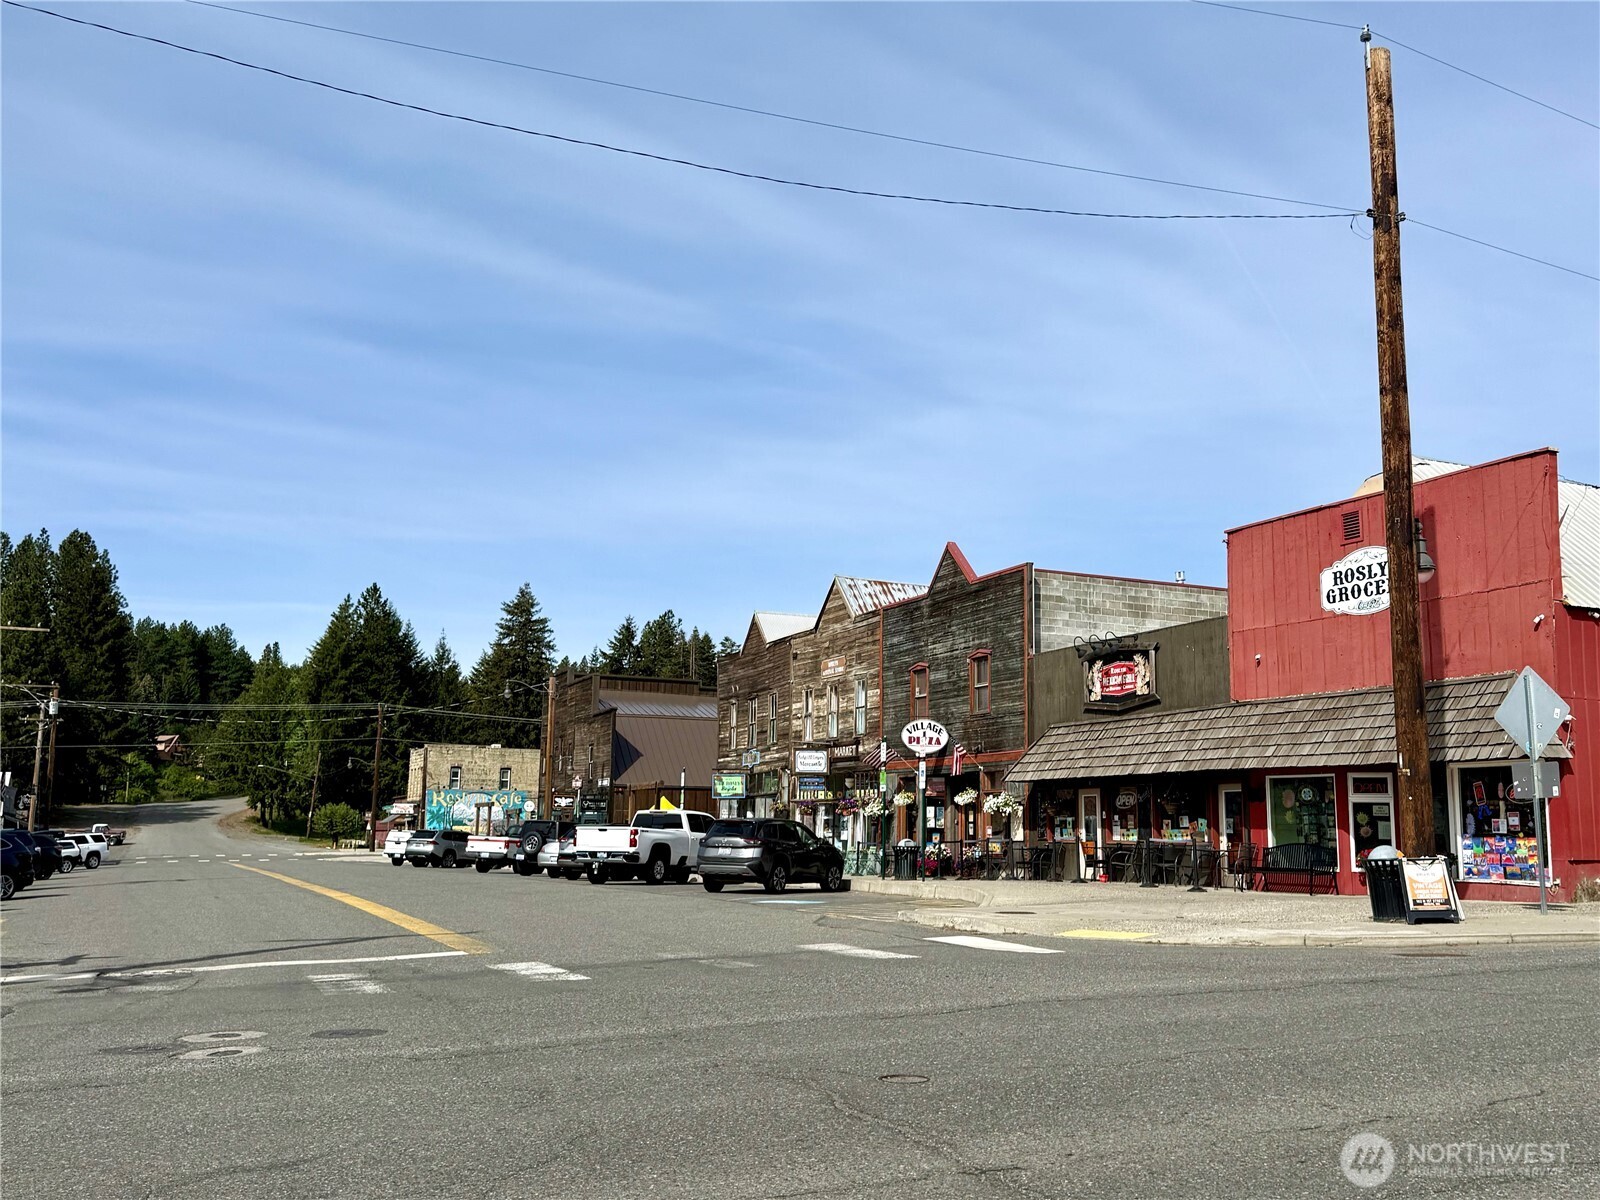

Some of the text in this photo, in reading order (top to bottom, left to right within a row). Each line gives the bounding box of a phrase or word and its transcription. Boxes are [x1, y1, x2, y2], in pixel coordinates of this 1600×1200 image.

[1332, 561, 1388, 587] ROSLY
[1326, 578, 1391, 604] GROCE
[906, 722, 944, 737] VILLAGE
[908, 736, 942, 746] PIZA
[432, 791, 523, 807] Roslyn Cafe
[1116, 794, 1135, 806] OPEN
